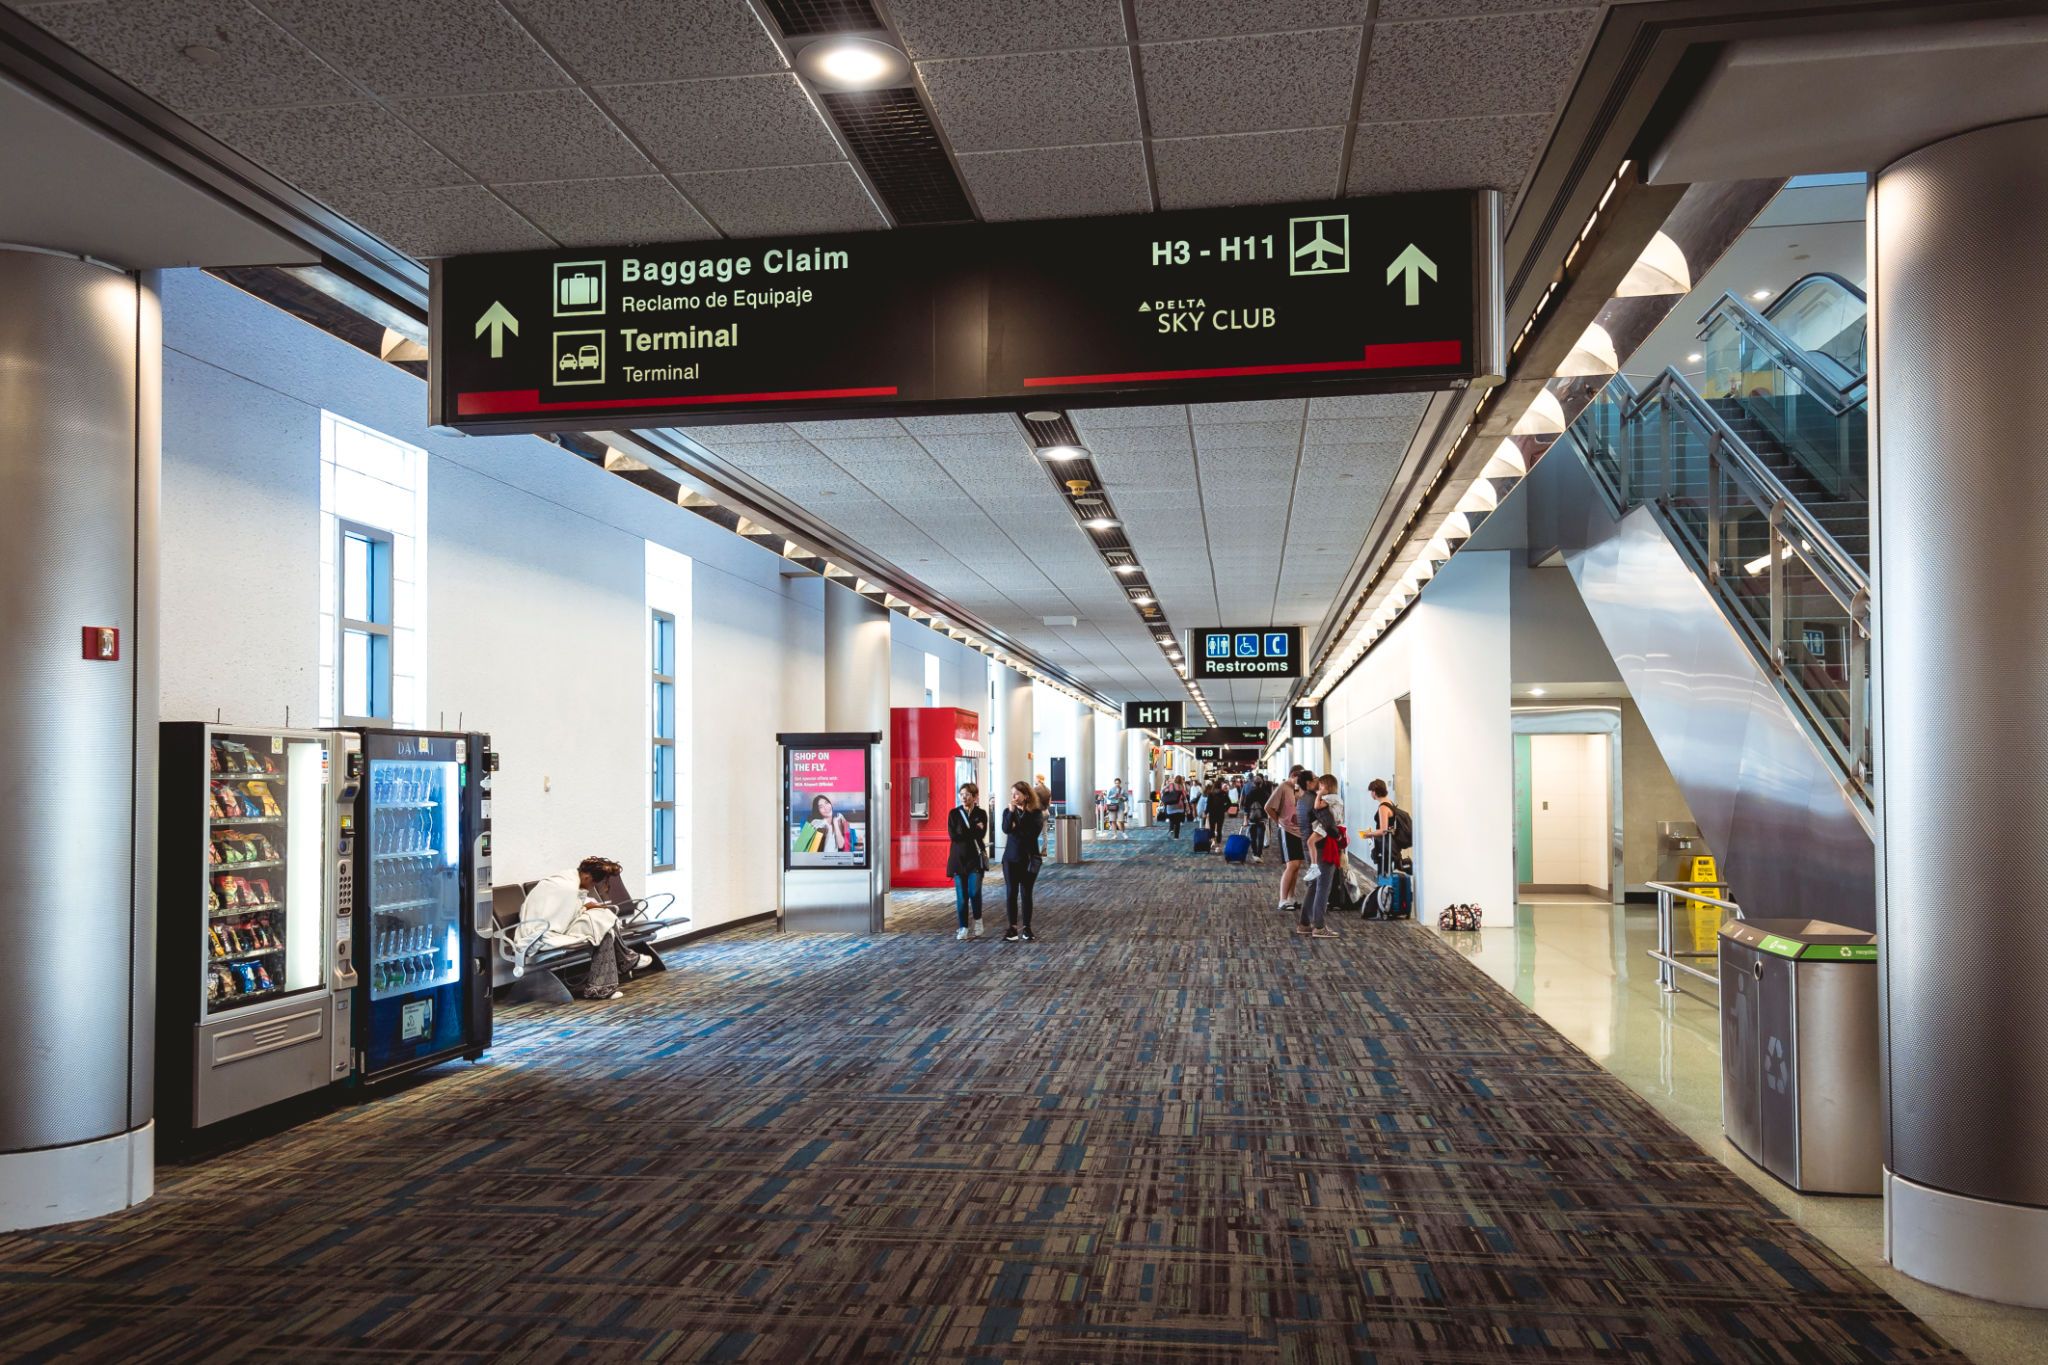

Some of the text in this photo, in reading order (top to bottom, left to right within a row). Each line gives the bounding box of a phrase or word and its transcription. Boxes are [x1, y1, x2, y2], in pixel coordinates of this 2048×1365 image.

[1152, 240, 1191, 266] H3
[1220, 234, 1274, 262] H11
[621, 247, 850, 287] Baggage Claim
[622, 286, 813, 313] Reclamo de Equipaje
[1155, 298, 1206, 310] DELTA
[1158, 307, 1276, 334] SKY CLUB
[620, 323, 738, 352] Terminal
[622, 363, 699, 383] Terminal
[1205, 660, 1289, 673] Restrooms
[1139, 707, 1170, 723] H11
[1295, 718, 1320, 726] Elevator
[794, 752, 829, 761] SHOP ON
[1201, 749, 1214, 757] H9
[794, 763, 810, 772] THE
